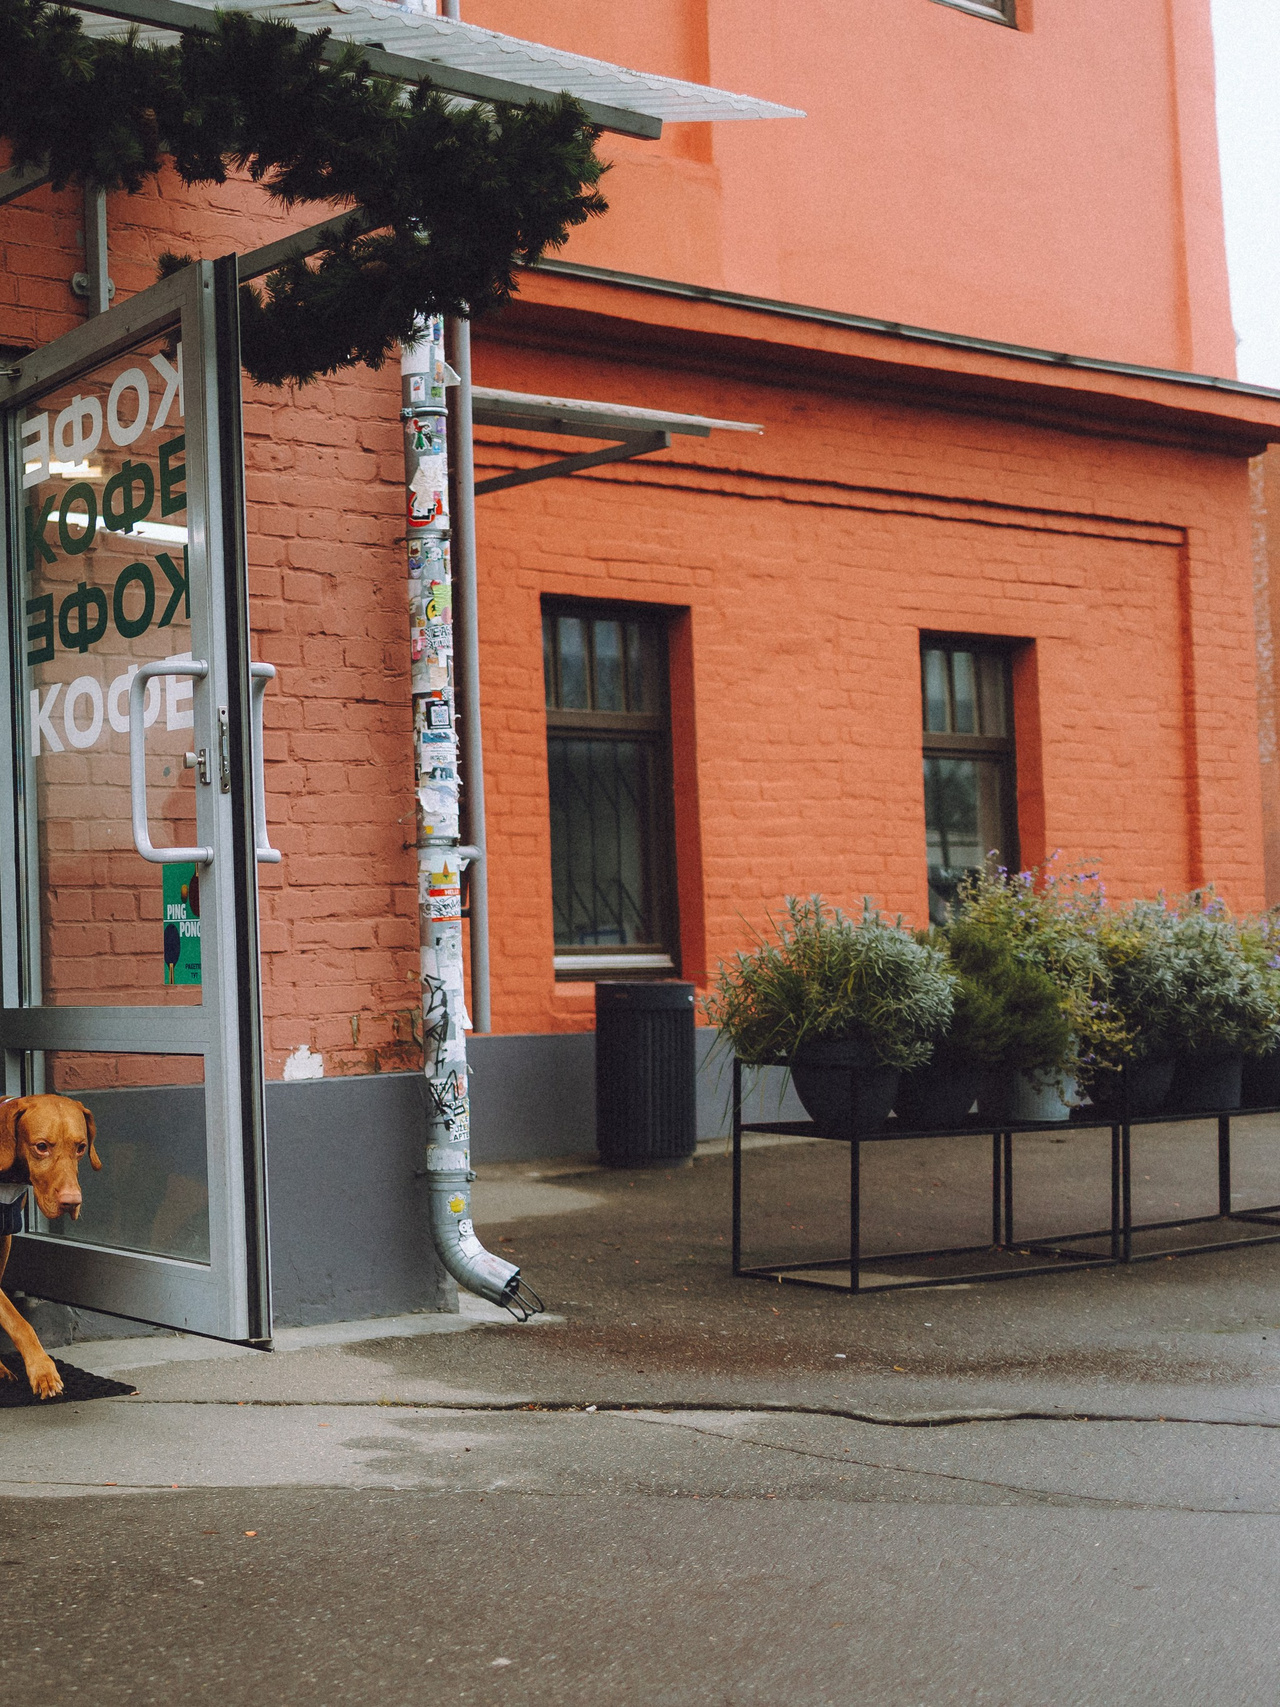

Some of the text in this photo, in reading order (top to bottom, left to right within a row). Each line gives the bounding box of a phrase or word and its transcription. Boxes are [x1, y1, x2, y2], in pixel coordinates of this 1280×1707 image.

[24, 434, 188, 572] КОФЕ
[30, 651, 195, 757] КОФЕ
[167, 903, 187, 920] PING
